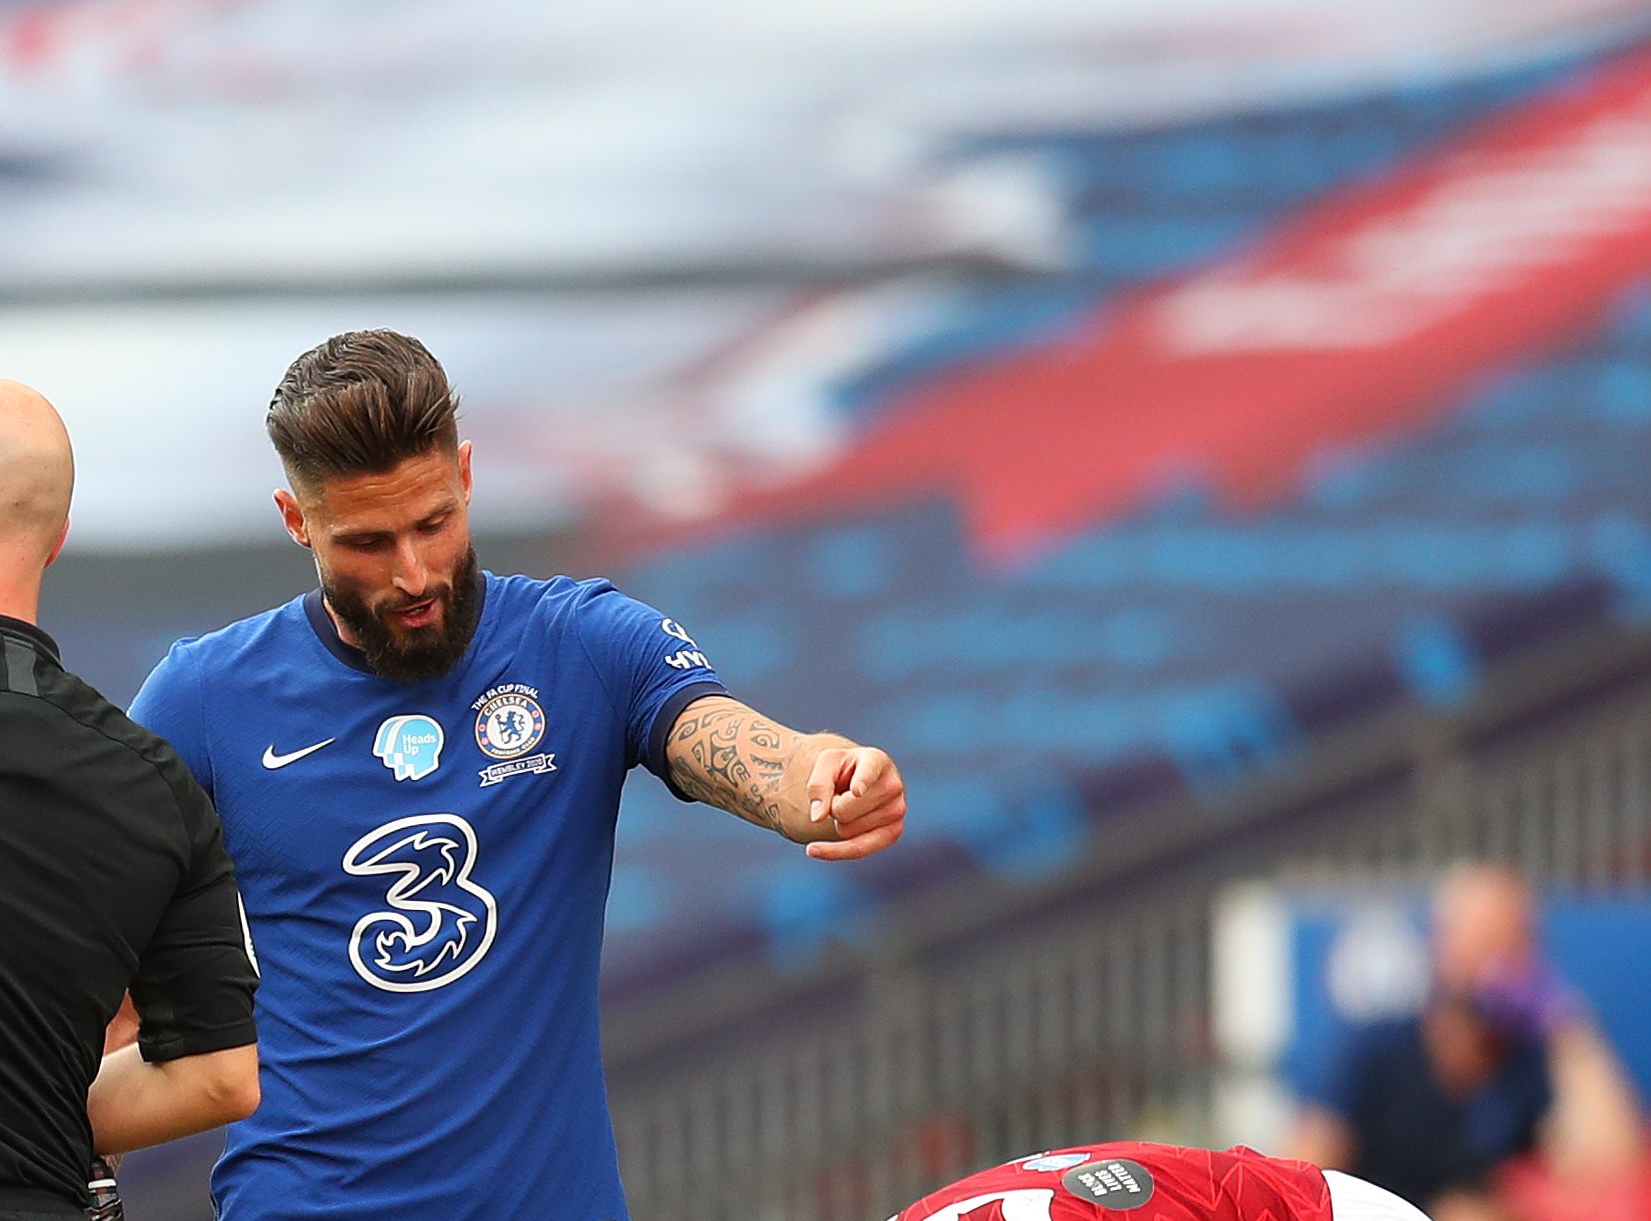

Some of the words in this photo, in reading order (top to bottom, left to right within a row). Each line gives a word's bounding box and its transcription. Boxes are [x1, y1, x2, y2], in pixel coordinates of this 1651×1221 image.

[471, 696, 488, 712] THE
[485, 687, 500, 700] FA
[497, 683, 515, 695] CUP
[513, 683, 540, 700] FINAL
[483, 695, 528, 717] CHELSEA
[402, 732, 437, 744] Heads
[403, 743, 420, 757] Up
[342, 813, 498, 993] 3
